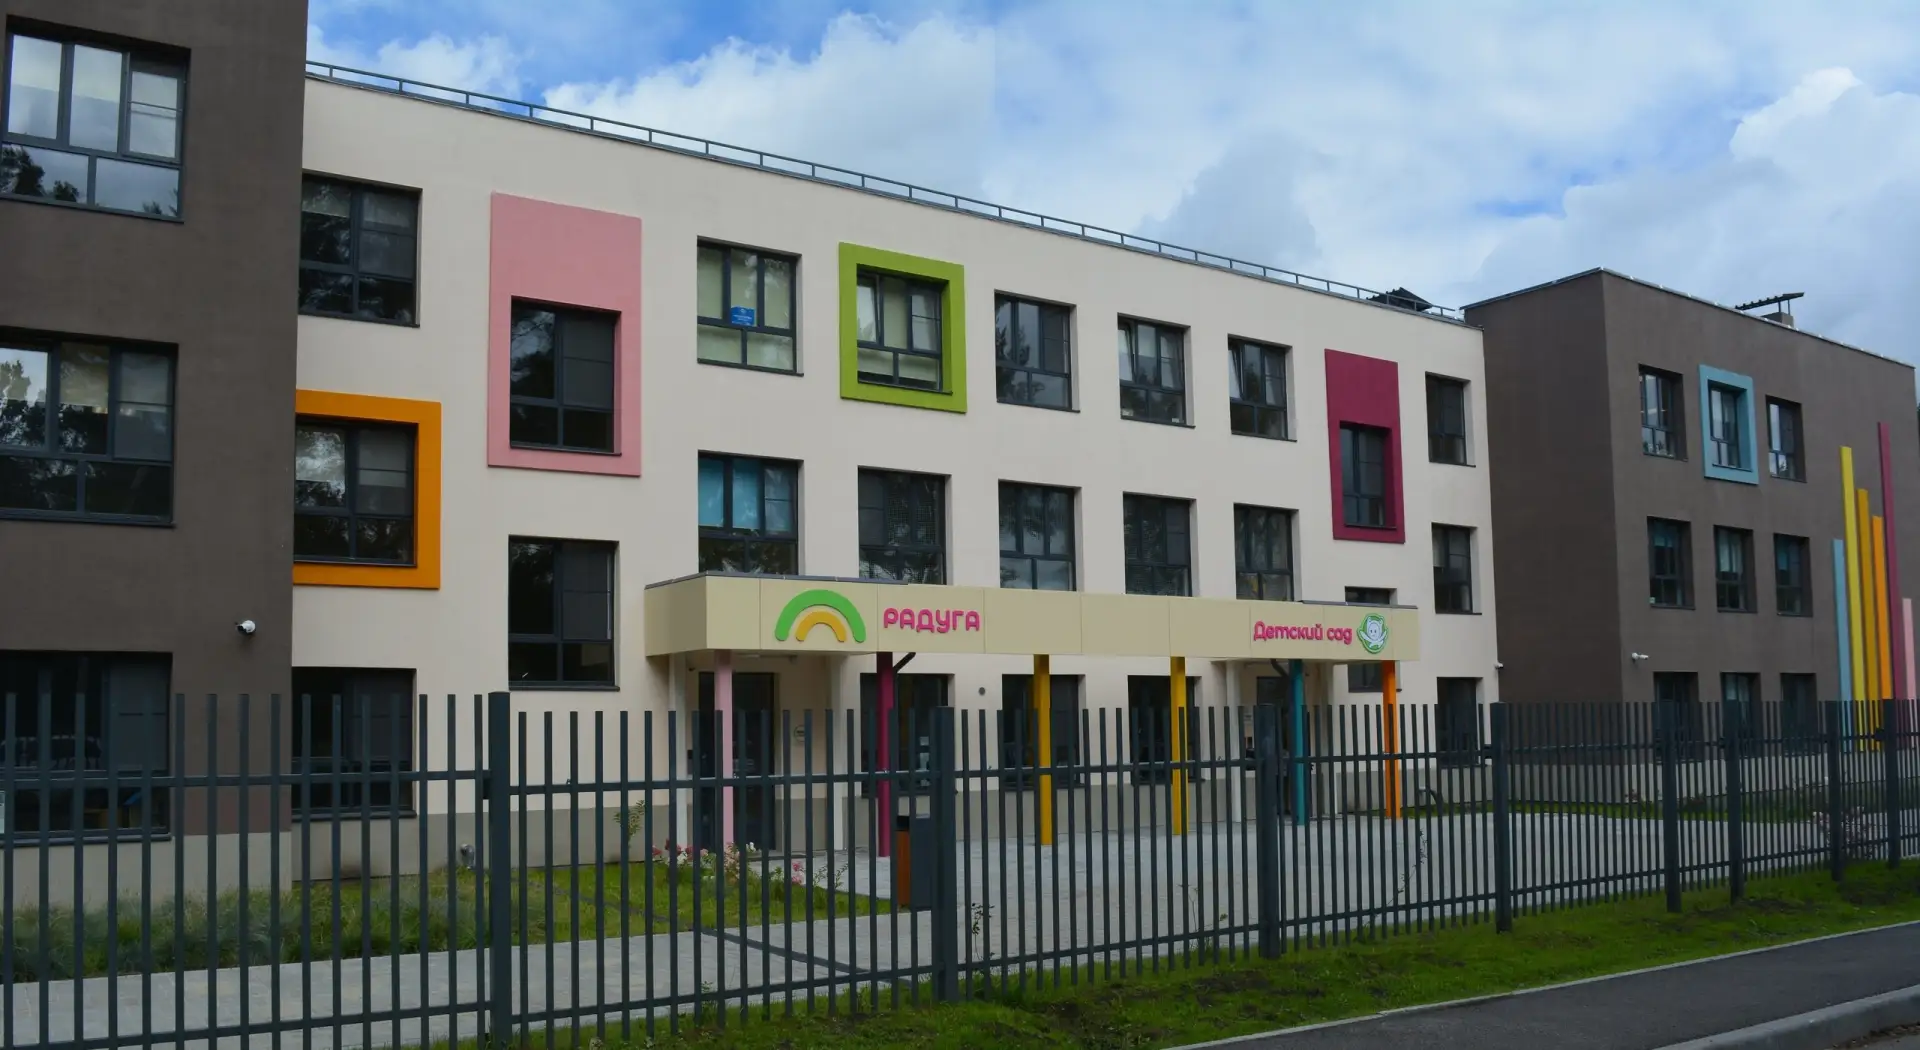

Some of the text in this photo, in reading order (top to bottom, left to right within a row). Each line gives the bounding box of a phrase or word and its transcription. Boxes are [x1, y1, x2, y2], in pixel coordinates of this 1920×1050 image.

[883, 607, 980, 633] РАДУГА
[1253, 620, 1352, 645] Детский сад
